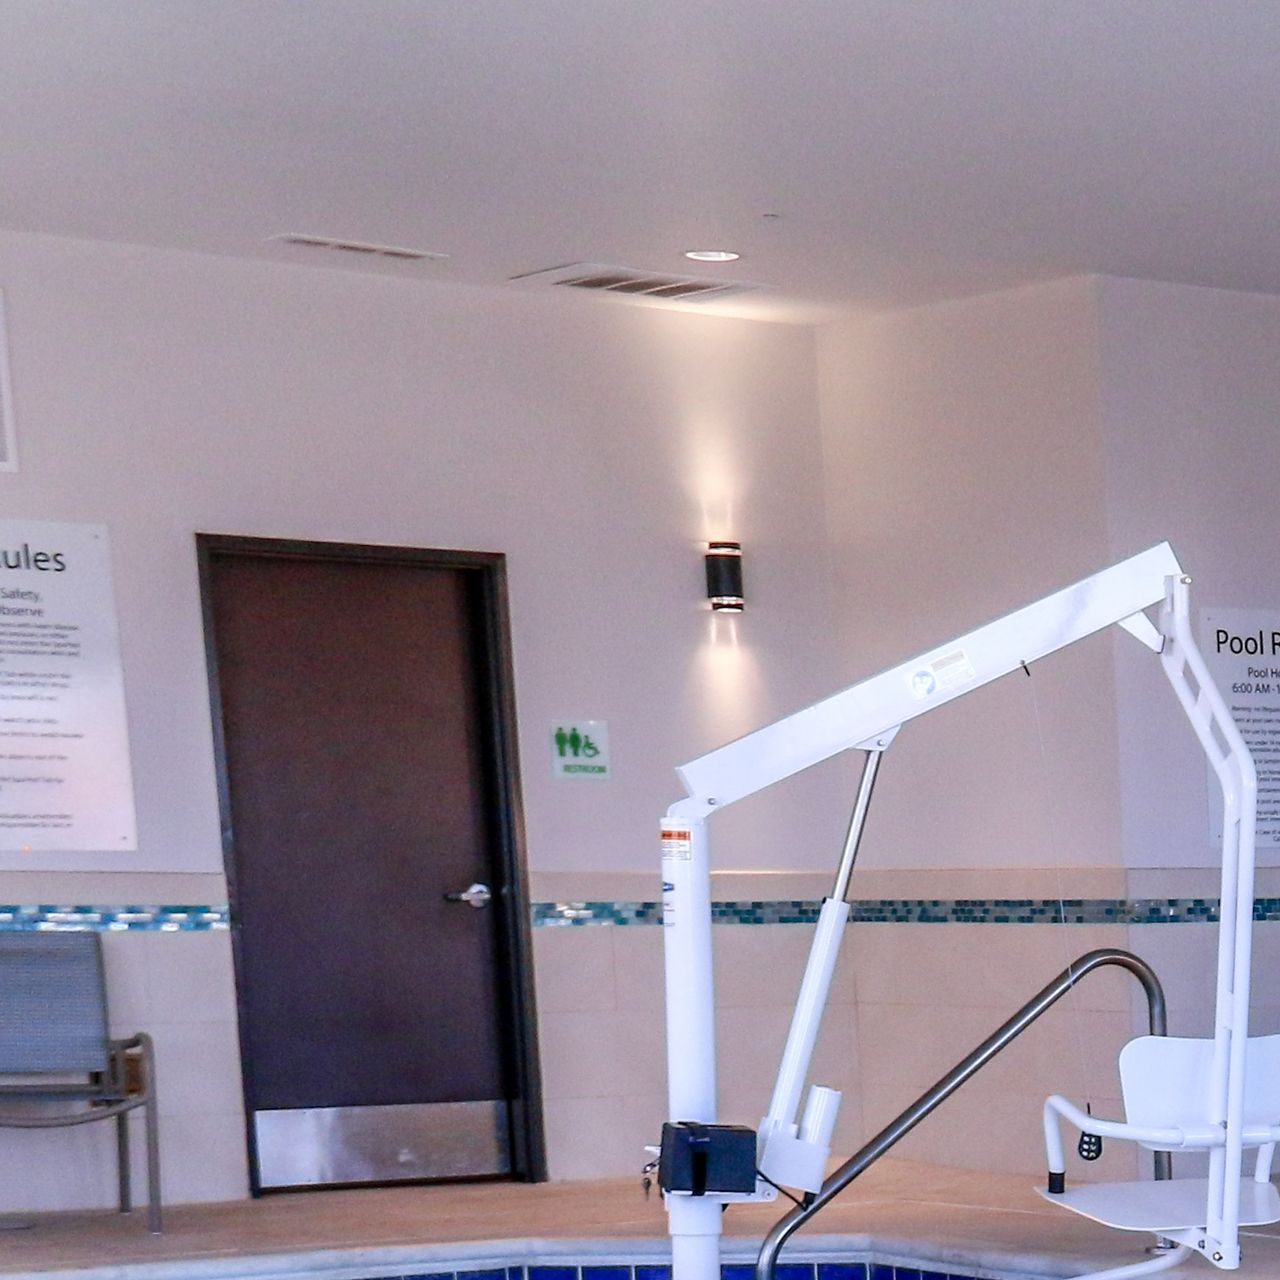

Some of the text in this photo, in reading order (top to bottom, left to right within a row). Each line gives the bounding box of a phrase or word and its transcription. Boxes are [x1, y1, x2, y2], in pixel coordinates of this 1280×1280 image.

[0, 543, 66, 572] ules
[0, 605, 43, 617] bserve
[1216, 629, 1264, 655] Pool
[1247, 667, 1268, 678] Pool
[1232, 683, 1252, 694] 6:00
[1254, 683, 1270, 694] AM
